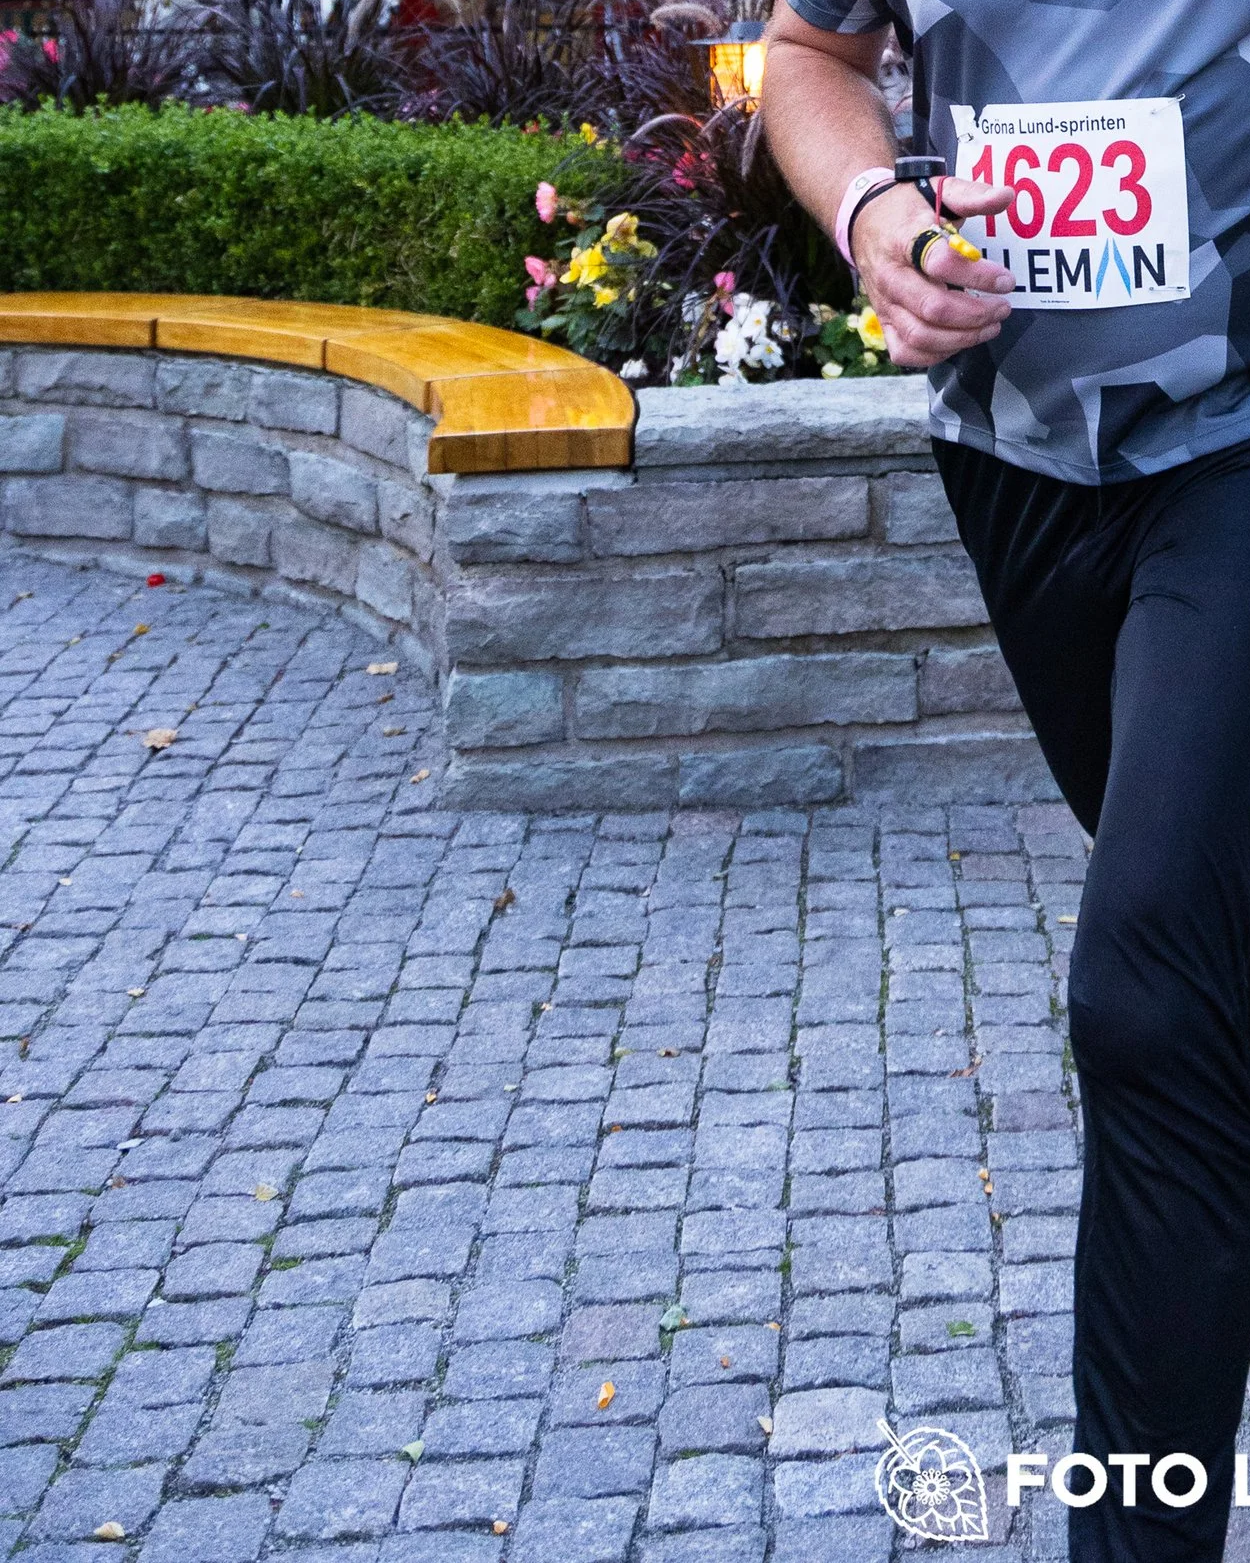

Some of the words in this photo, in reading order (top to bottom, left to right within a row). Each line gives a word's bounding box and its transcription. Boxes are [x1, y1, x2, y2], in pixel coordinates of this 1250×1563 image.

[981, 118, 1015, 135] Gröna
[1018, 115, 1126, 136] Lund-sprinten
[972, 140, 1152, 239] 1623
[981, 239, 1166, 300] LEMAN
